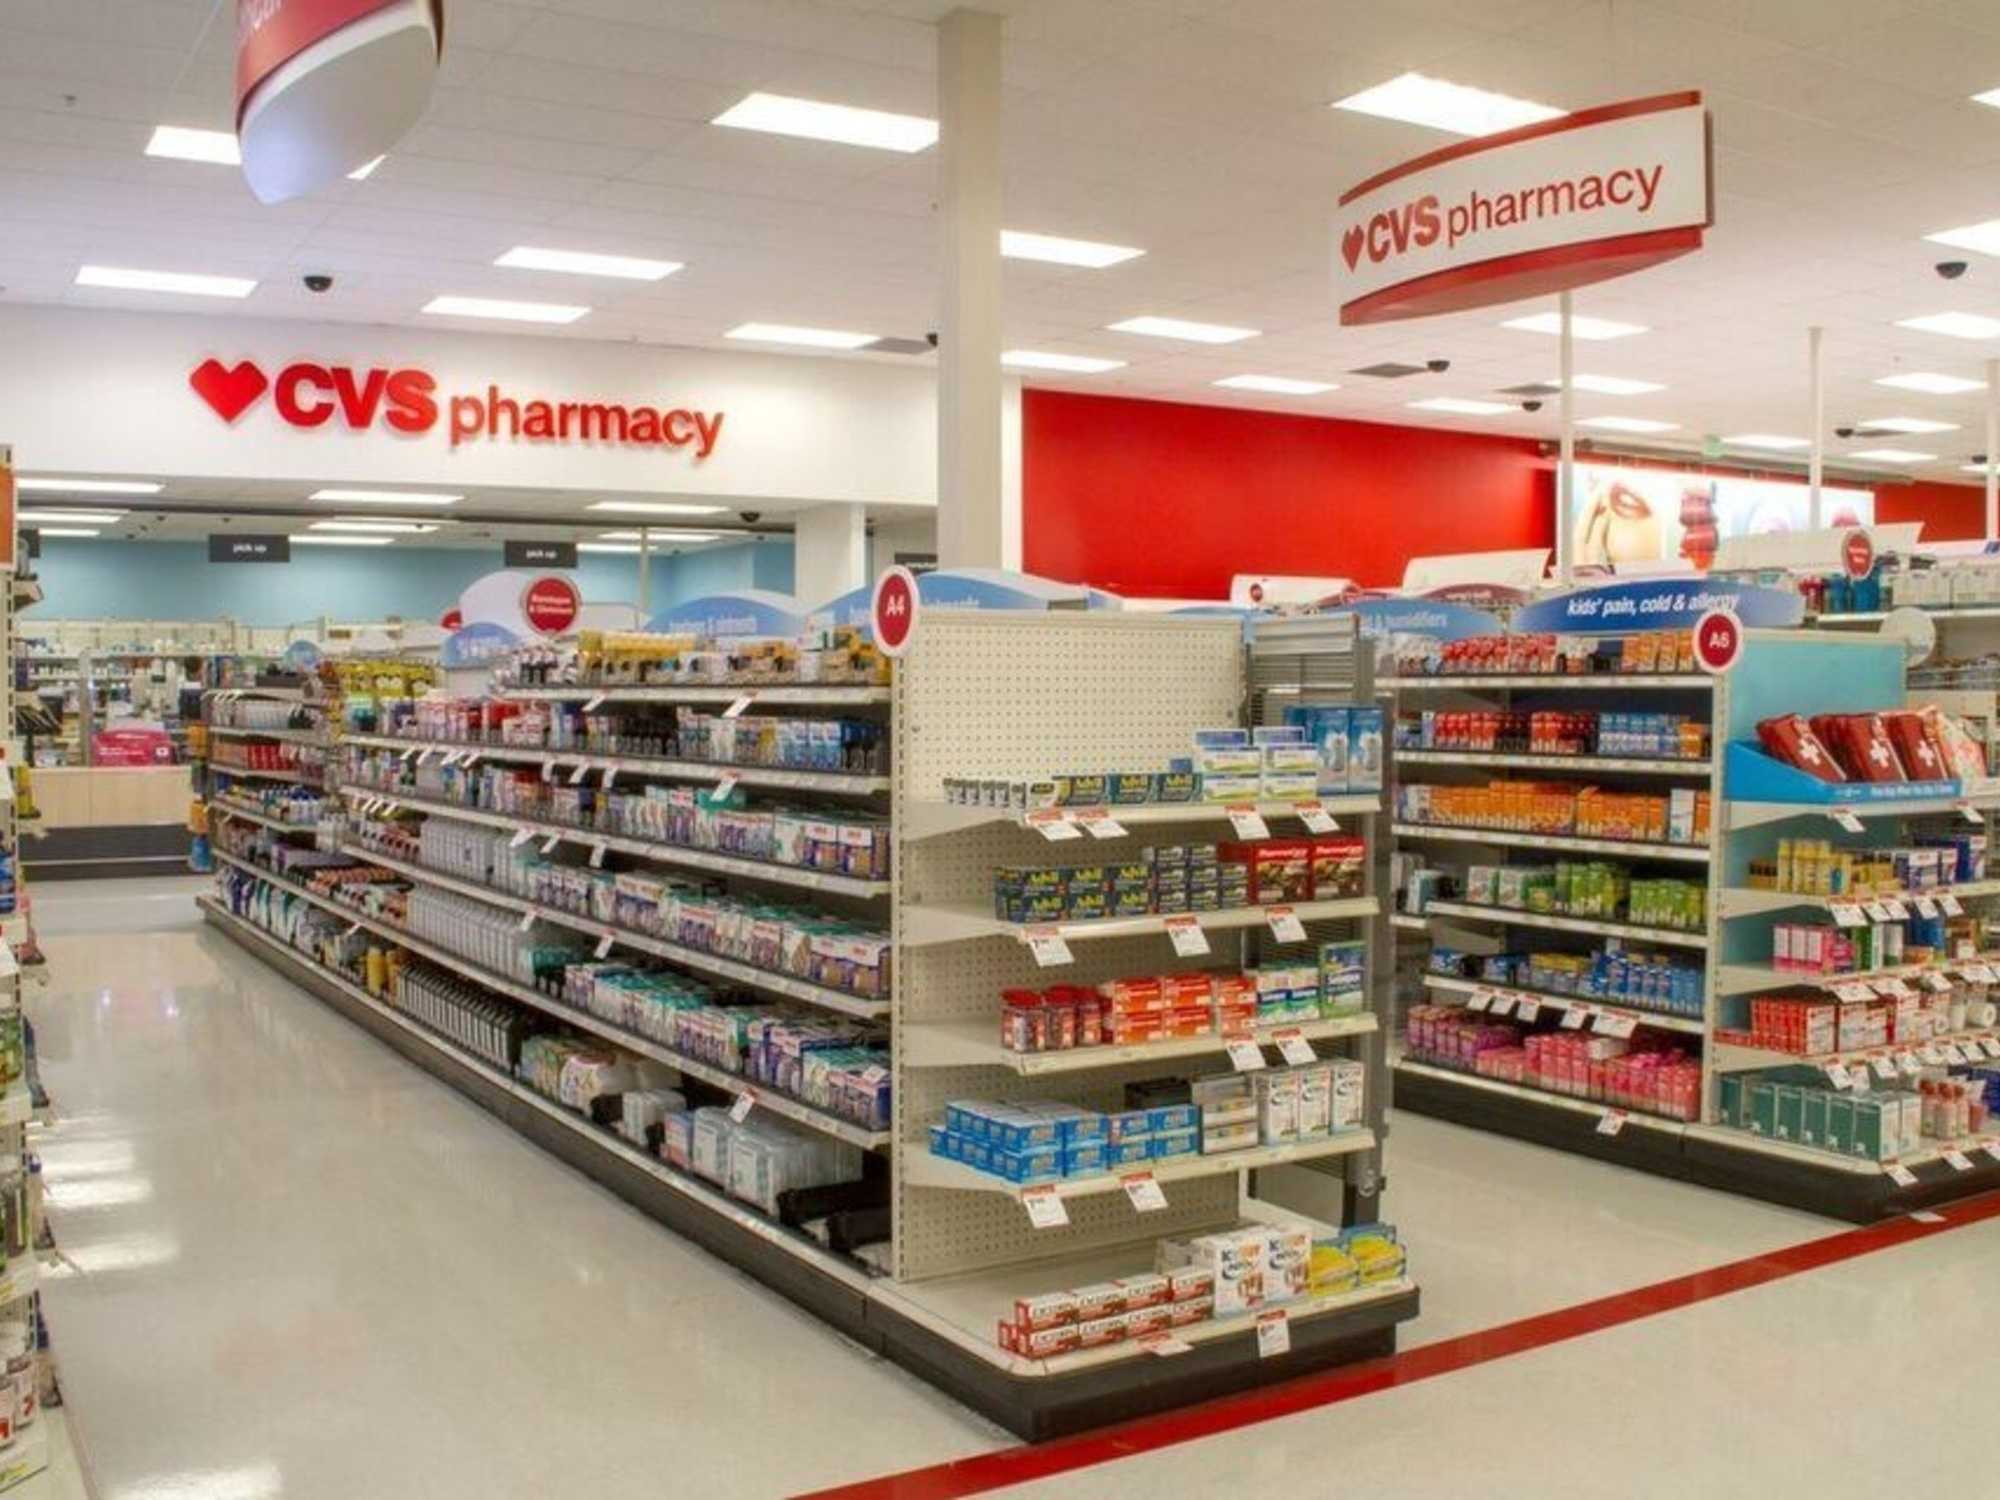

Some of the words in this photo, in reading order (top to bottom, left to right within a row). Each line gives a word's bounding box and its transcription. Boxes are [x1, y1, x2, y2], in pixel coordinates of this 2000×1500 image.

[1367, 194, 1441, 263] CVS
[1446, 164, 1663, 248] pharmacy
[274, 362, 438, 433] CVS
[450, 385, 725, 458] pharmacy
[886, 594, 906, 617] A4
[1567, 596, 1603, 617] kids'
[1602, 596, 1637, 618] pain,
[1640, 594, 1673, 614] cold
[1672, 592, 1686, 612] &
